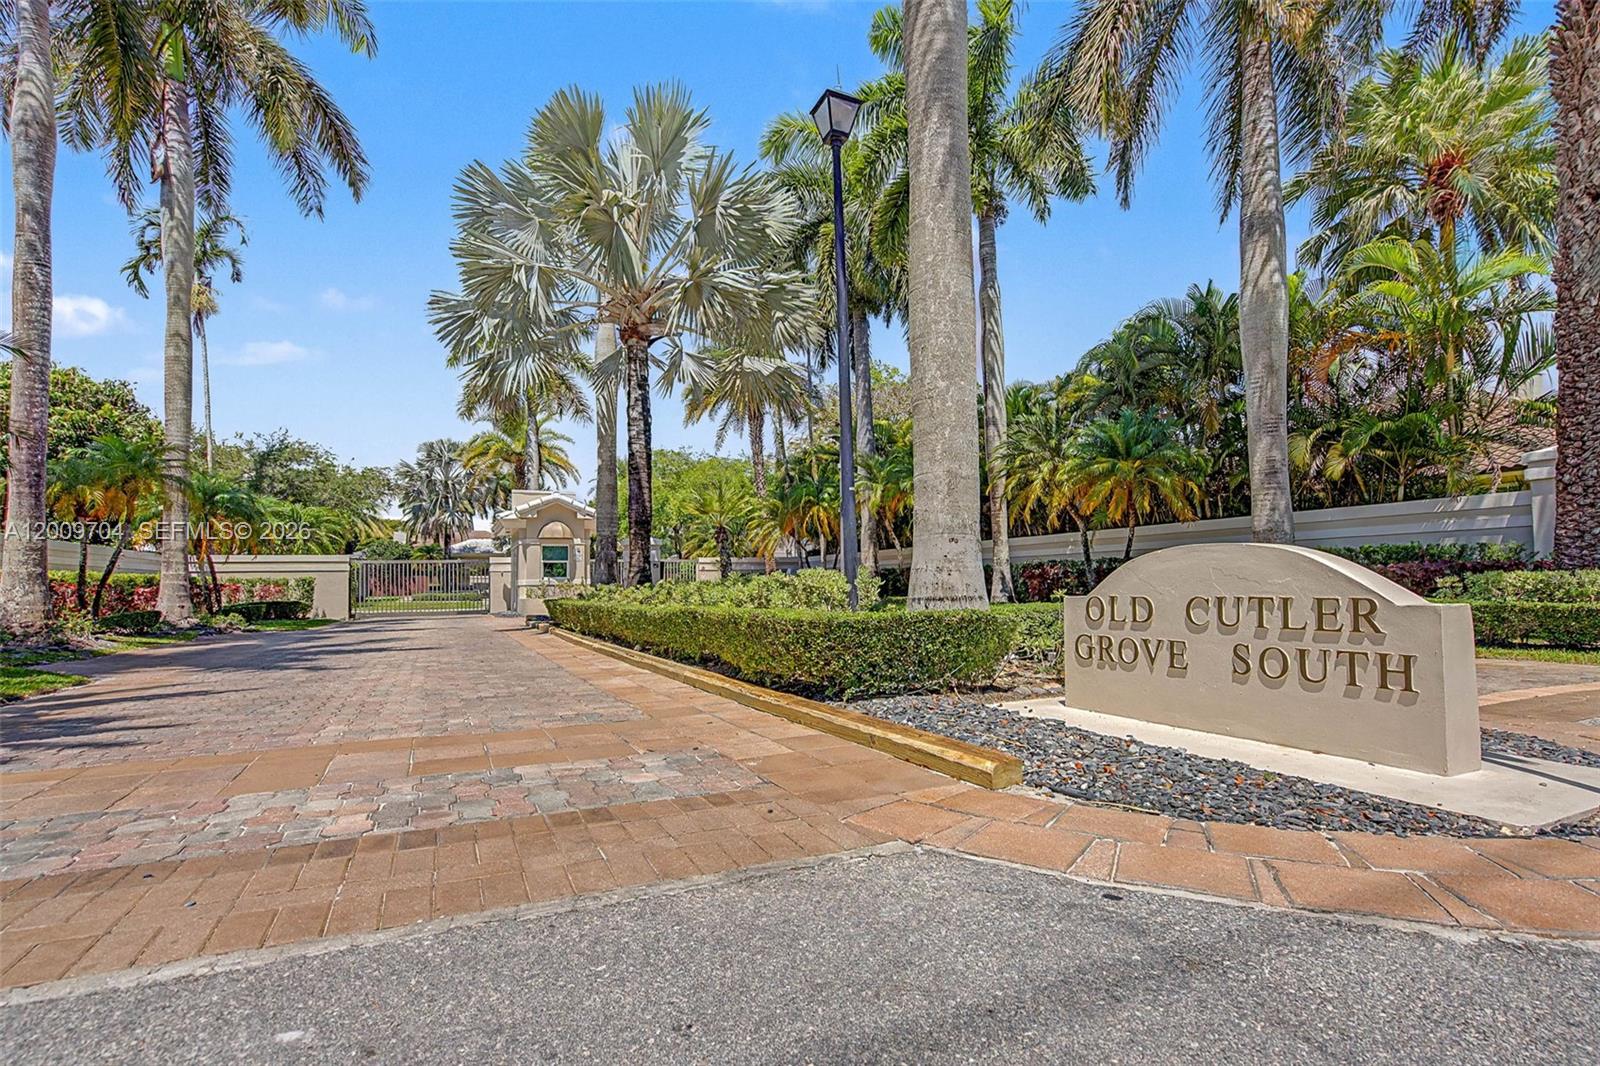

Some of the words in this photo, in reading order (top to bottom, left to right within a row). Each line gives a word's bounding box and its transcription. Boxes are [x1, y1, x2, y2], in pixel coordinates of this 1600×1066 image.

[1085, 595, 1154, 623] OLD
[1185, 596, 1387, 634] CUTLER
[1074, 633, 1189, 671] GROVE
[1231, 643, 1420, 694] SOUTH
